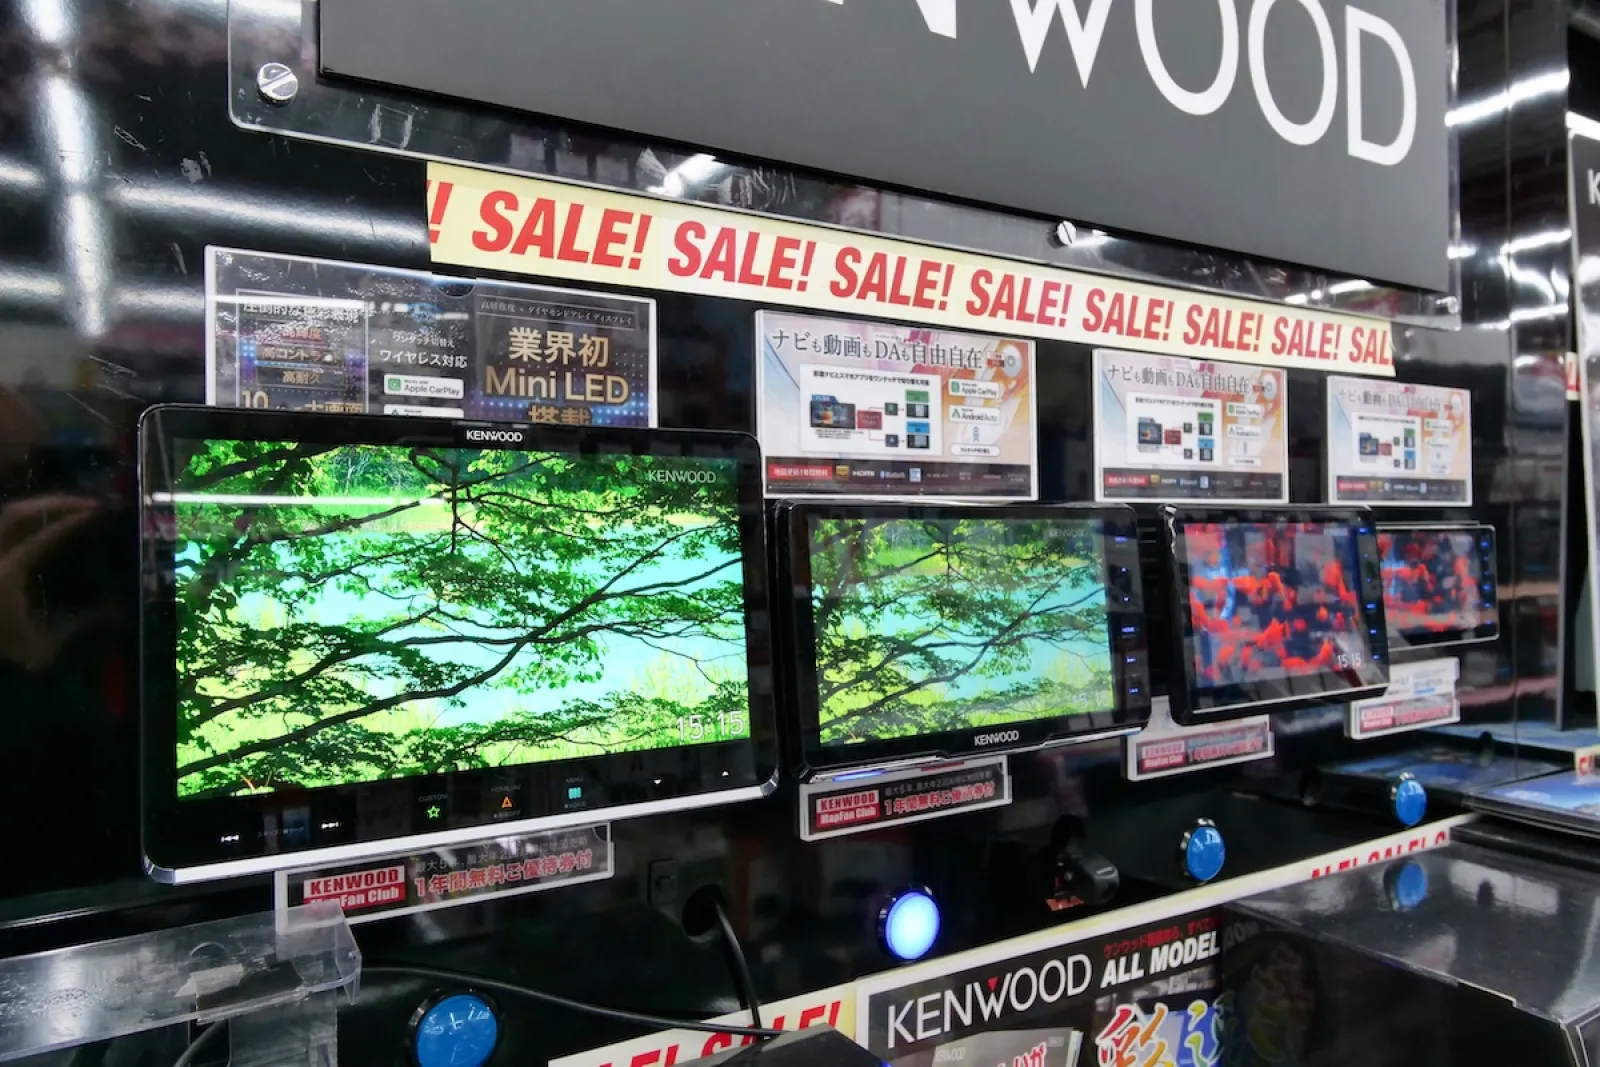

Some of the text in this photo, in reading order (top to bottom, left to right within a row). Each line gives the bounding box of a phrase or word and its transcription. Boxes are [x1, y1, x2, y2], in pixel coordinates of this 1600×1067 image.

[472, 189, 653, 271] SALE!
[667, 219, 817, 292] SALE!
[829, 247, 956, 312] SALE!
[965, 268, 1073, 327] SALE!
[1081, 288, 1175, 342] SALE!
[1182, 305, 1264, 353] SALE!
[1271, 316, 1343, 361] SALE!
[1349, 326, 1396, 366] SAL
[379, 350, 468, 369] ワイヤレス対応
[507, 327, 610, 368] 業界初
[771, 329, 983, 370] ナビも動画もDAも自由自在
[404, 384, 460, 396] Apple CarPlay
[485, 365, 629, 405] Mini LED
[465, 429, 524, 443] KENWOOD
[648, 469, 717, 484] KENWOOD
[1337, 652, 1362, 669] 15:15
[676, 710, 745, 741] 15:15
[974, 730, 1020, 746] KENWOOD
[820, 791, 876, 811] KENWOOD
[310, 868, 400, 896] KENWOOD
[310, 885, 401, 907] Fan Club
[1100, 952, 1145, 989] ALL
[1149, 930, 1221, 975] MODEL
[887, 953, 1093, 1049] KENWOOD
